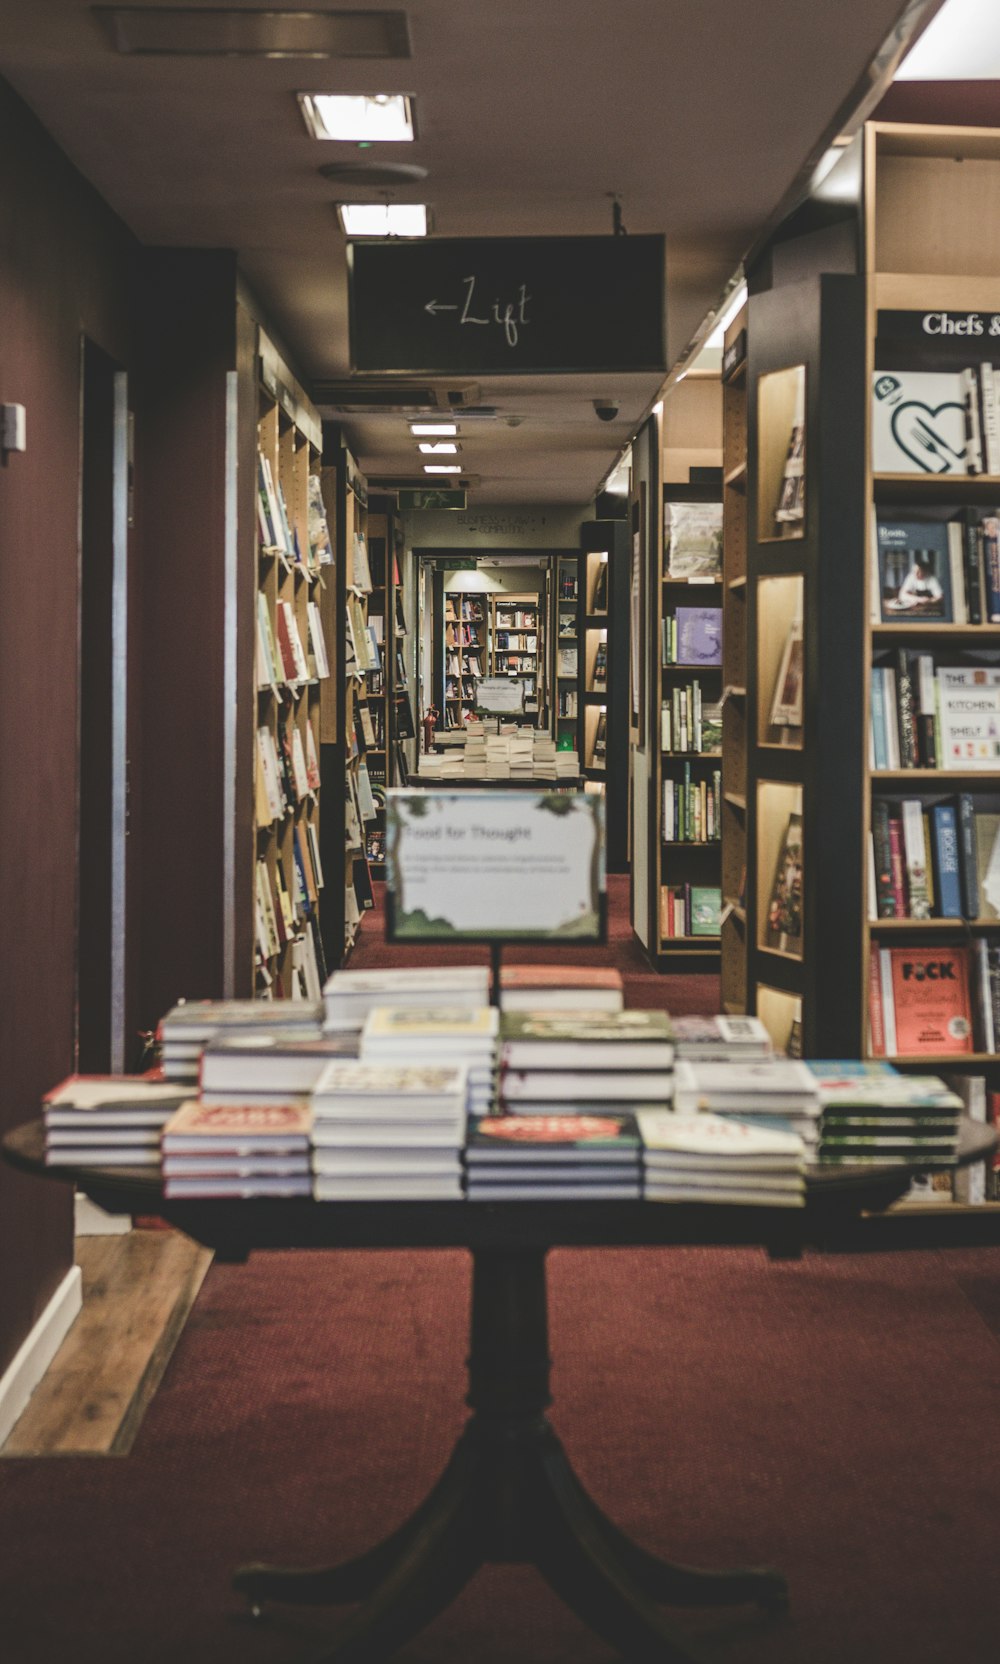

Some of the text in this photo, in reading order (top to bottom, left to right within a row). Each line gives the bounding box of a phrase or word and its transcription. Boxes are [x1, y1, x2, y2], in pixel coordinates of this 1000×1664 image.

[922, 313, 984, 336] Chefs
[945, 673, 967, 684] THE
[947, 701, 996, 710] KITCHEN
[446, 826, 466, 840] for
[471, 827, 532, 843] Thought
[942, 827, 957, 873] BOCUSE
